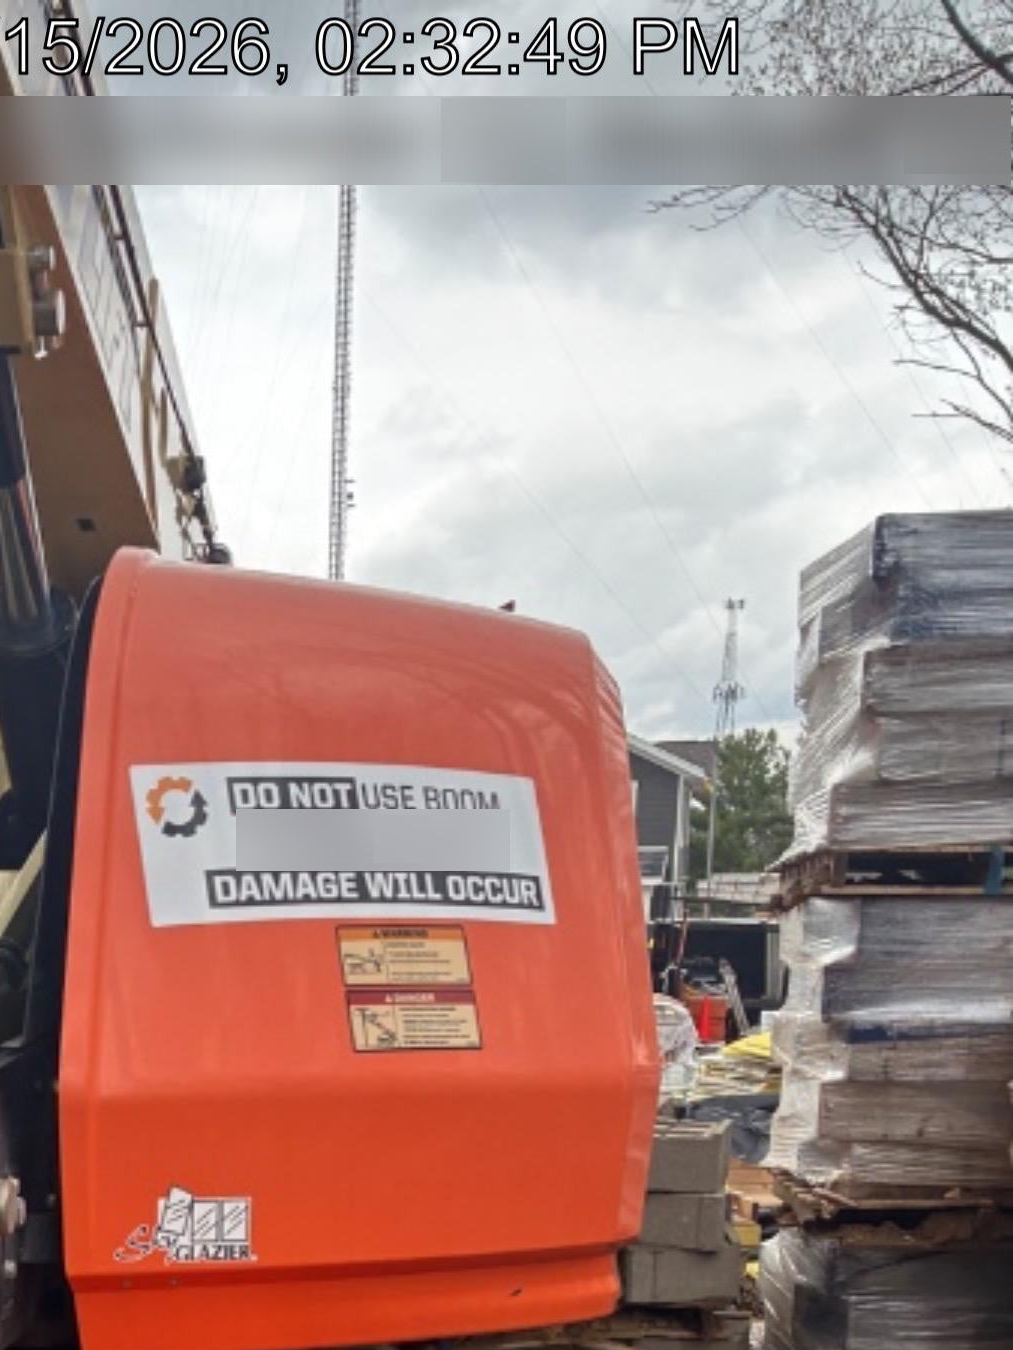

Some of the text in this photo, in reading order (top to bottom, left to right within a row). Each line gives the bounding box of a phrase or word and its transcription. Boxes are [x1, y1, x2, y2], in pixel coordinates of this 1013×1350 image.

[233, 782, 280, 809] DO
[289, 782, 352, 809] NOT
[362, 783, 416, 809] USE
[214, 871, 539, 907] DAMAGE WILL OCCUR
